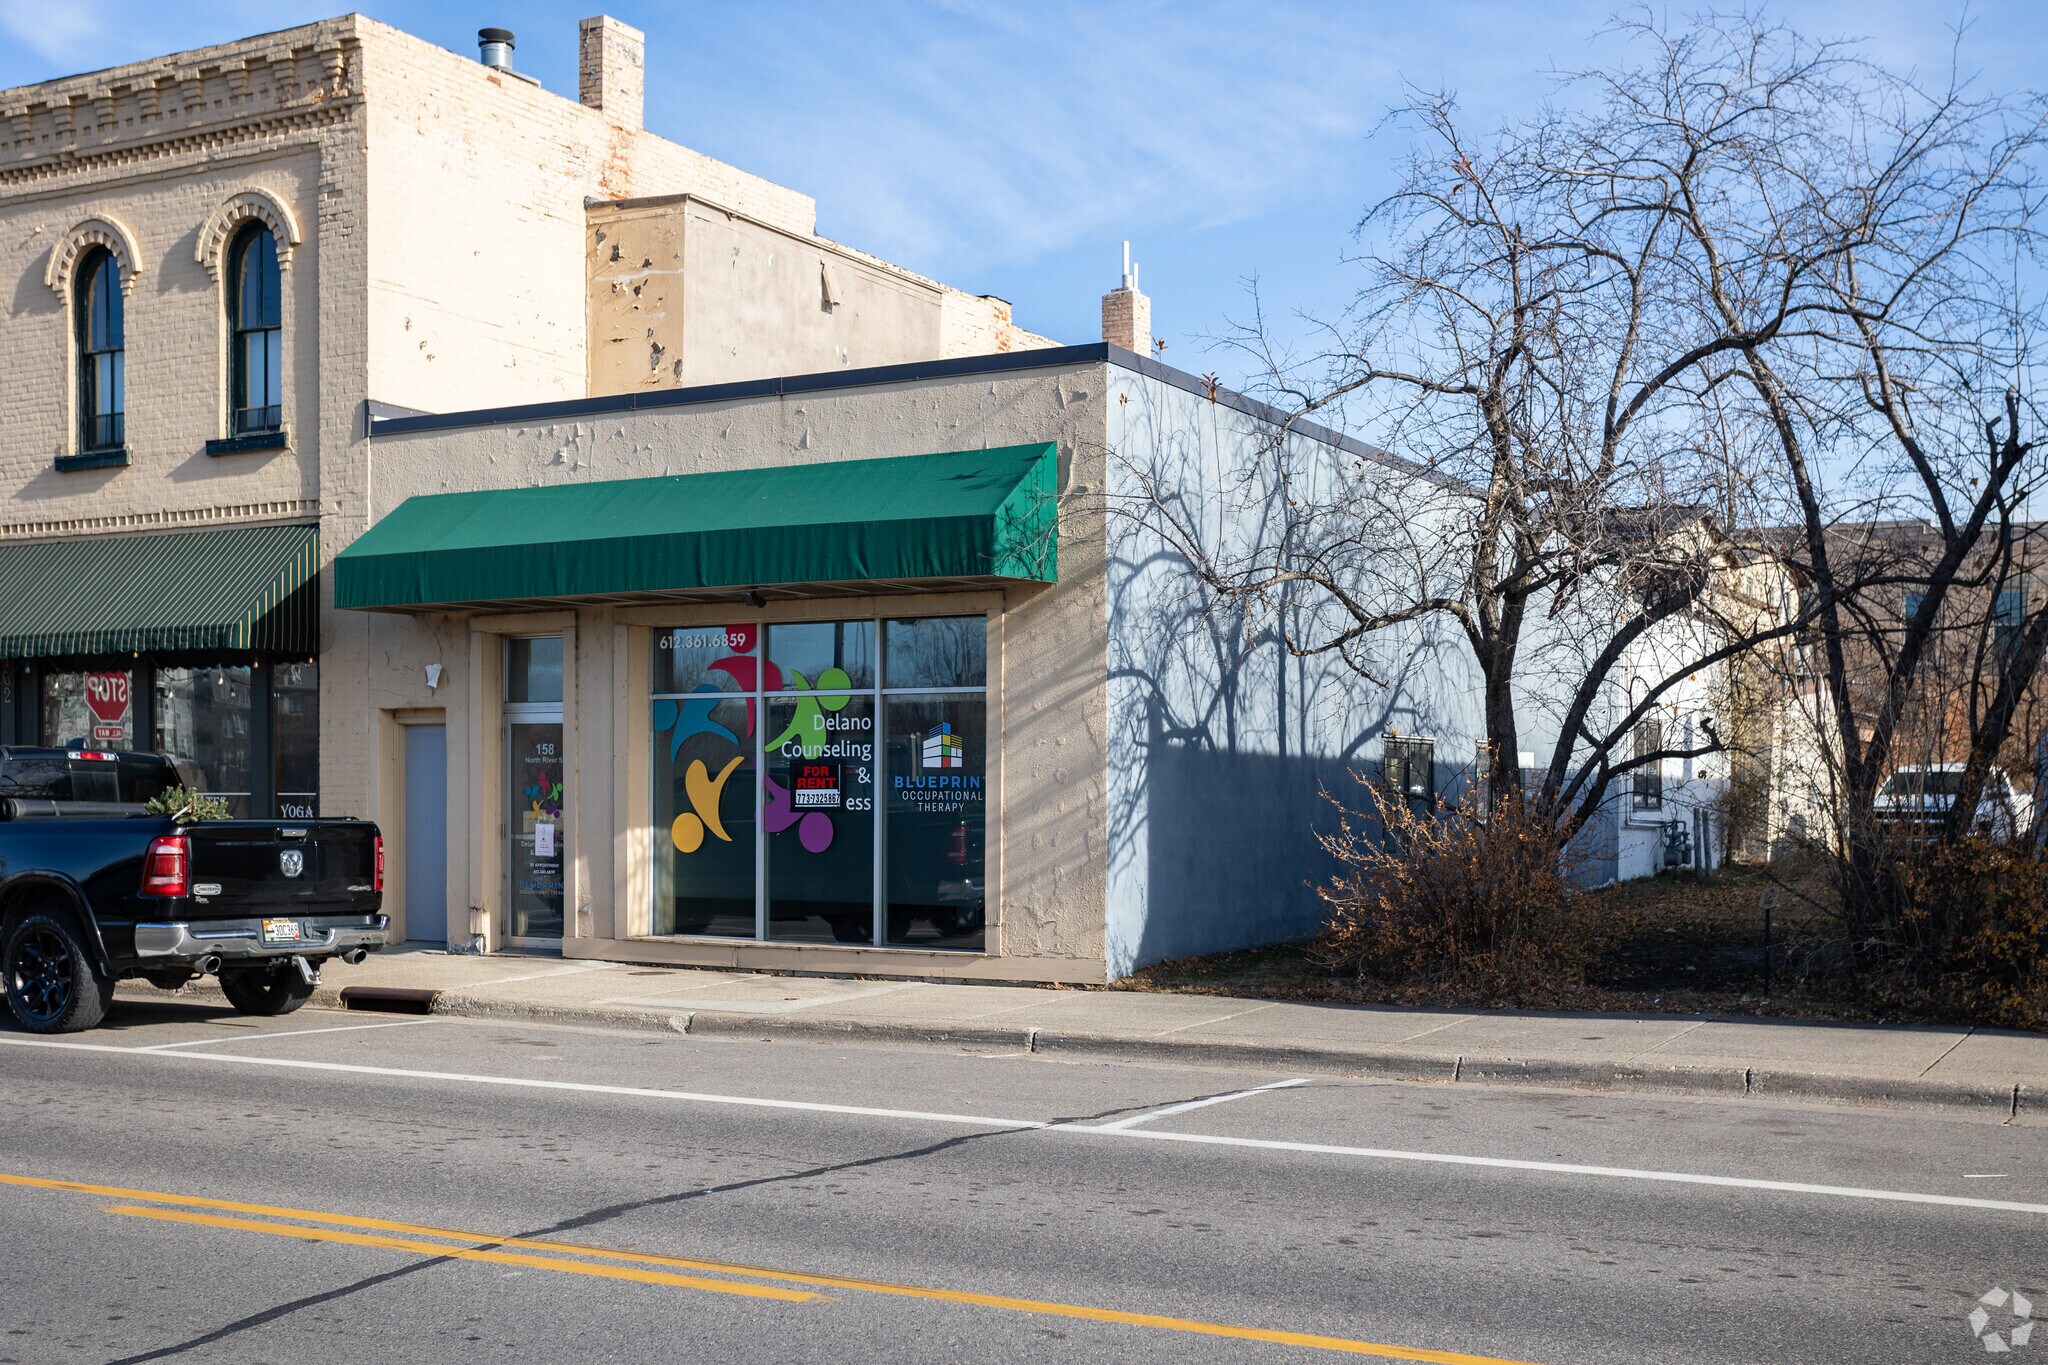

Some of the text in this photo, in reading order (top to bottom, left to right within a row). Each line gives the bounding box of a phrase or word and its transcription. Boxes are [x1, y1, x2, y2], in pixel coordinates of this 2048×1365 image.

[660, 633, 746, 649] 612.361.6859
[814, 713, 872, 731] Delano
[536, 743, 554, 755] 158
[781, 740, 872, 761] Counseling
[525, 756, 541, 764] North
[542, 756, 557, 764] River
[804, 766, 829, 777] FOR
[858, 767, 872, 784] &
[797, 778, 836, 789] RENT
[895, 776, 985, 788] BLUEPRIN
[902, 790, 983, 801] OCCUPATIONAL
[281, 803, 314, 818] YOGA
[918, 802, 965, 812] THERAPY
[520, 881, 563, 889] BLUEPRIN
